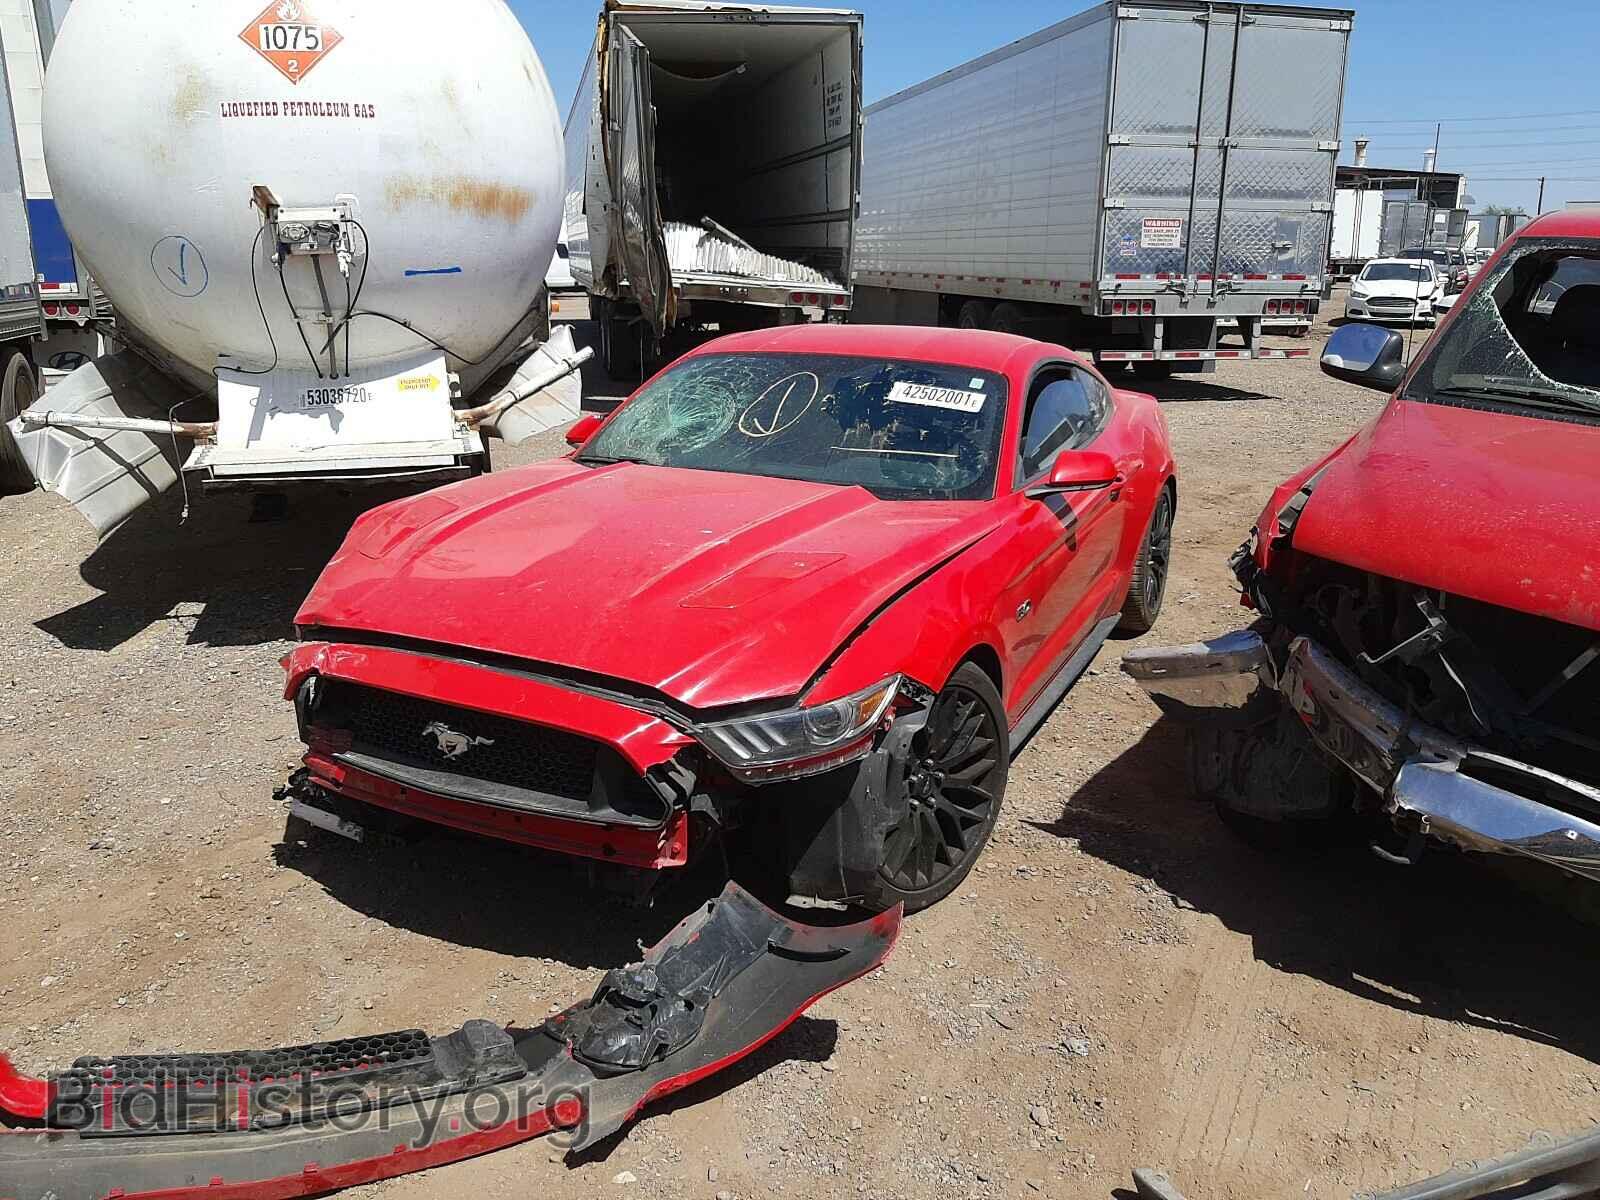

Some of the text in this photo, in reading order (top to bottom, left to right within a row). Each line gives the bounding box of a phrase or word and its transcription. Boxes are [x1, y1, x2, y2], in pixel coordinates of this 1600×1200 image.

[263, 25, 319, 50] 1075
[287, 59, 299, 73] 2
[220, 101, 375, 119] LIQUEFIED PETROLEUM GAS
[307, 387, 367, 405] 53036720
[902, 385, 972, 407] 42502001
